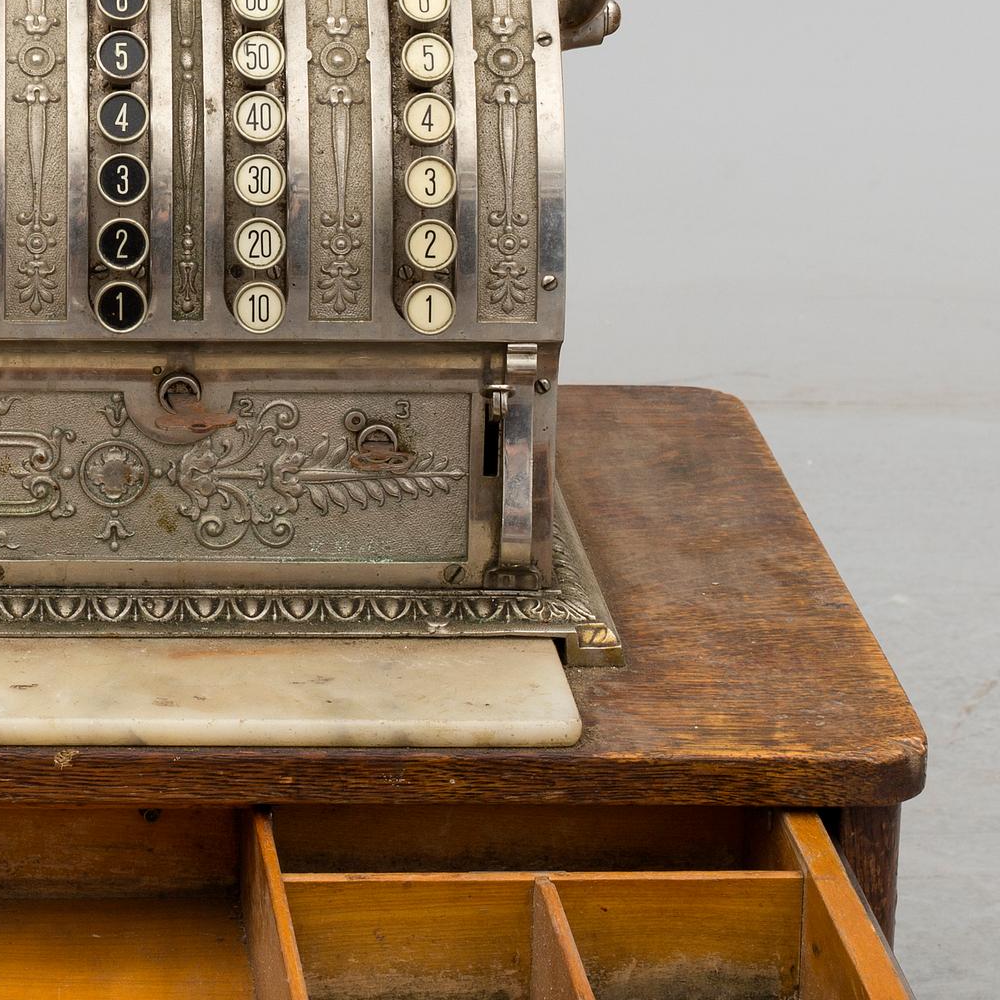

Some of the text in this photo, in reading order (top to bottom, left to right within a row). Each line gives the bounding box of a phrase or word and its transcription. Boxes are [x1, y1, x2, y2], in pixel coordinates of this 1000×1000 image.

[115, 42, 128, 70] 5
[246, 43, 269, 70] 50
[422, 44, 435, 72] 5
[114, 102, 129, 132] 4
[246, 102, 272, 131] 40
[421, 103, 434, 132] 4
[116, 164, 129, 195] 3
[248, 165, 272, 195] 30
[424, 167, 436, 197] 3
[115, 229, 128, 259] 2
[248, 229, 272, 259] 20
[424, 230, 437, 259] 2
[115, 291, 123, 321] 1
[249, 294, 270, 323] 10
[425, 294, 432, 324] 1
[238, 398, 254, 418] 2
[395, 400, 411, 419] 3
